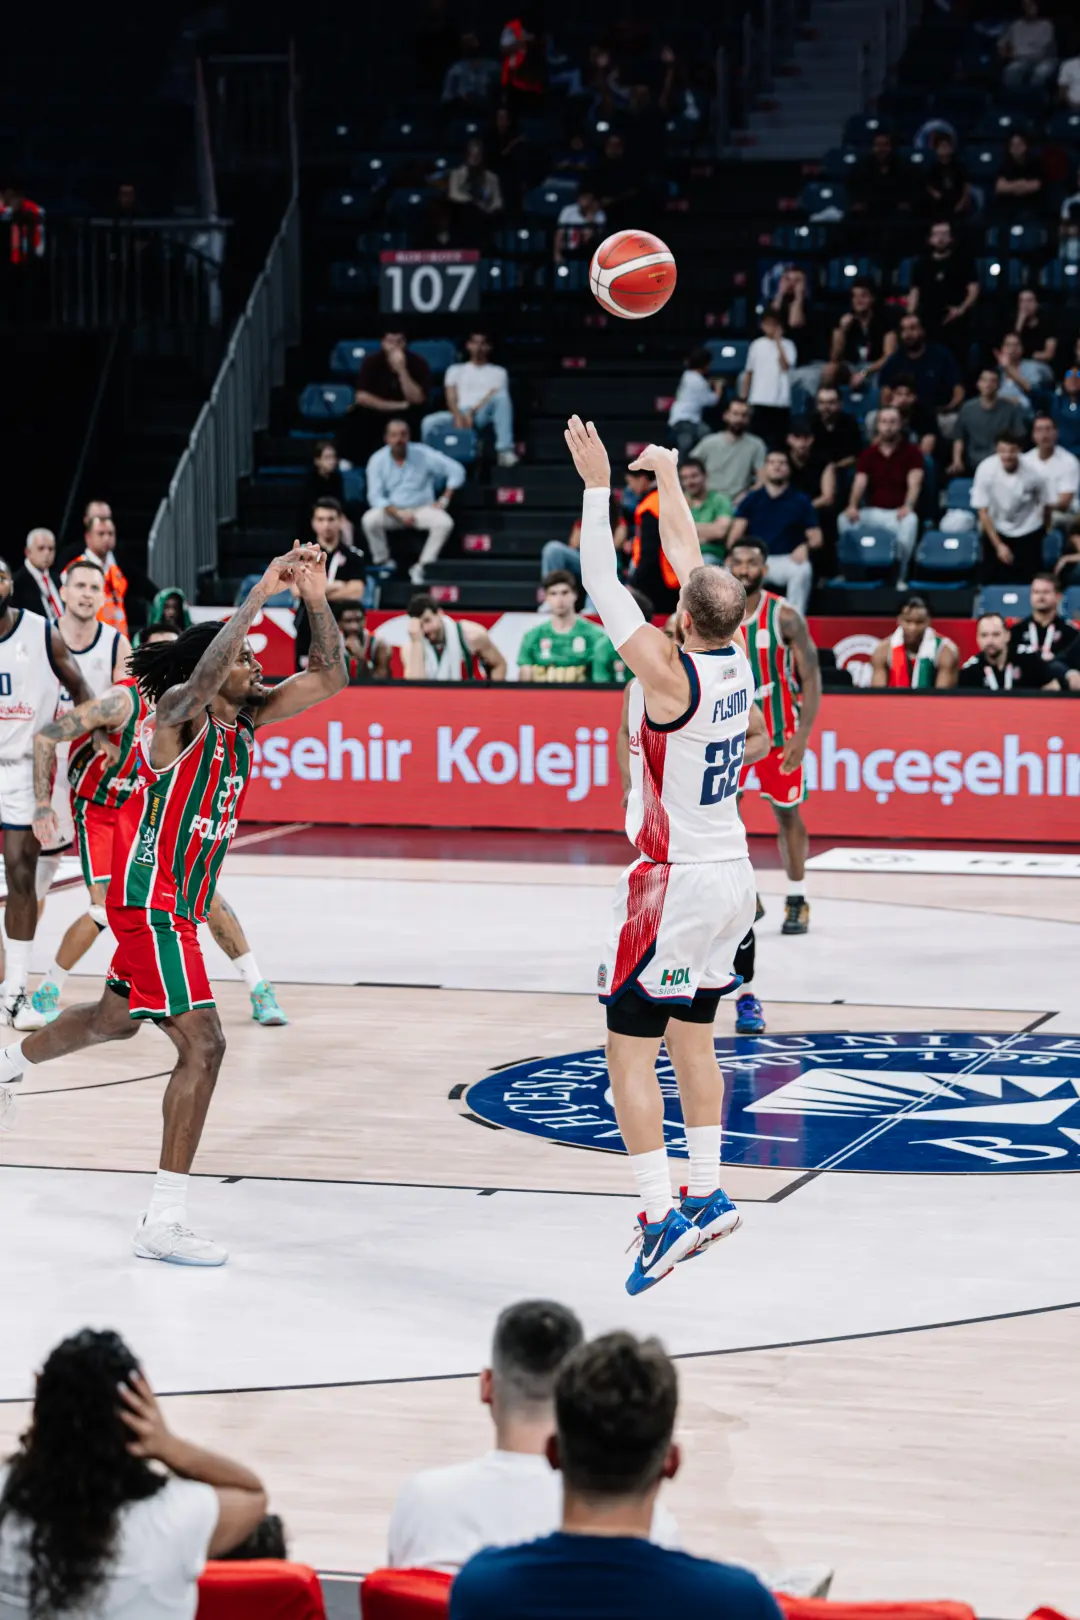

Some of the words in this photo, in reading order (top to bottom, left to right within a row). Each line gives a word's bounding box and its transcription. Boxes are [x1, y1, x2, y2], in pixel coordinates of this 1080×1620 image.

[385, 265, 476, 313] 107
[712, 688, 747, 724] FLYNN
[437, 725, 609, 802] Koleji
[699, 731, 746, 806] 22
[918, 1051, 1058, 1065] 1998
